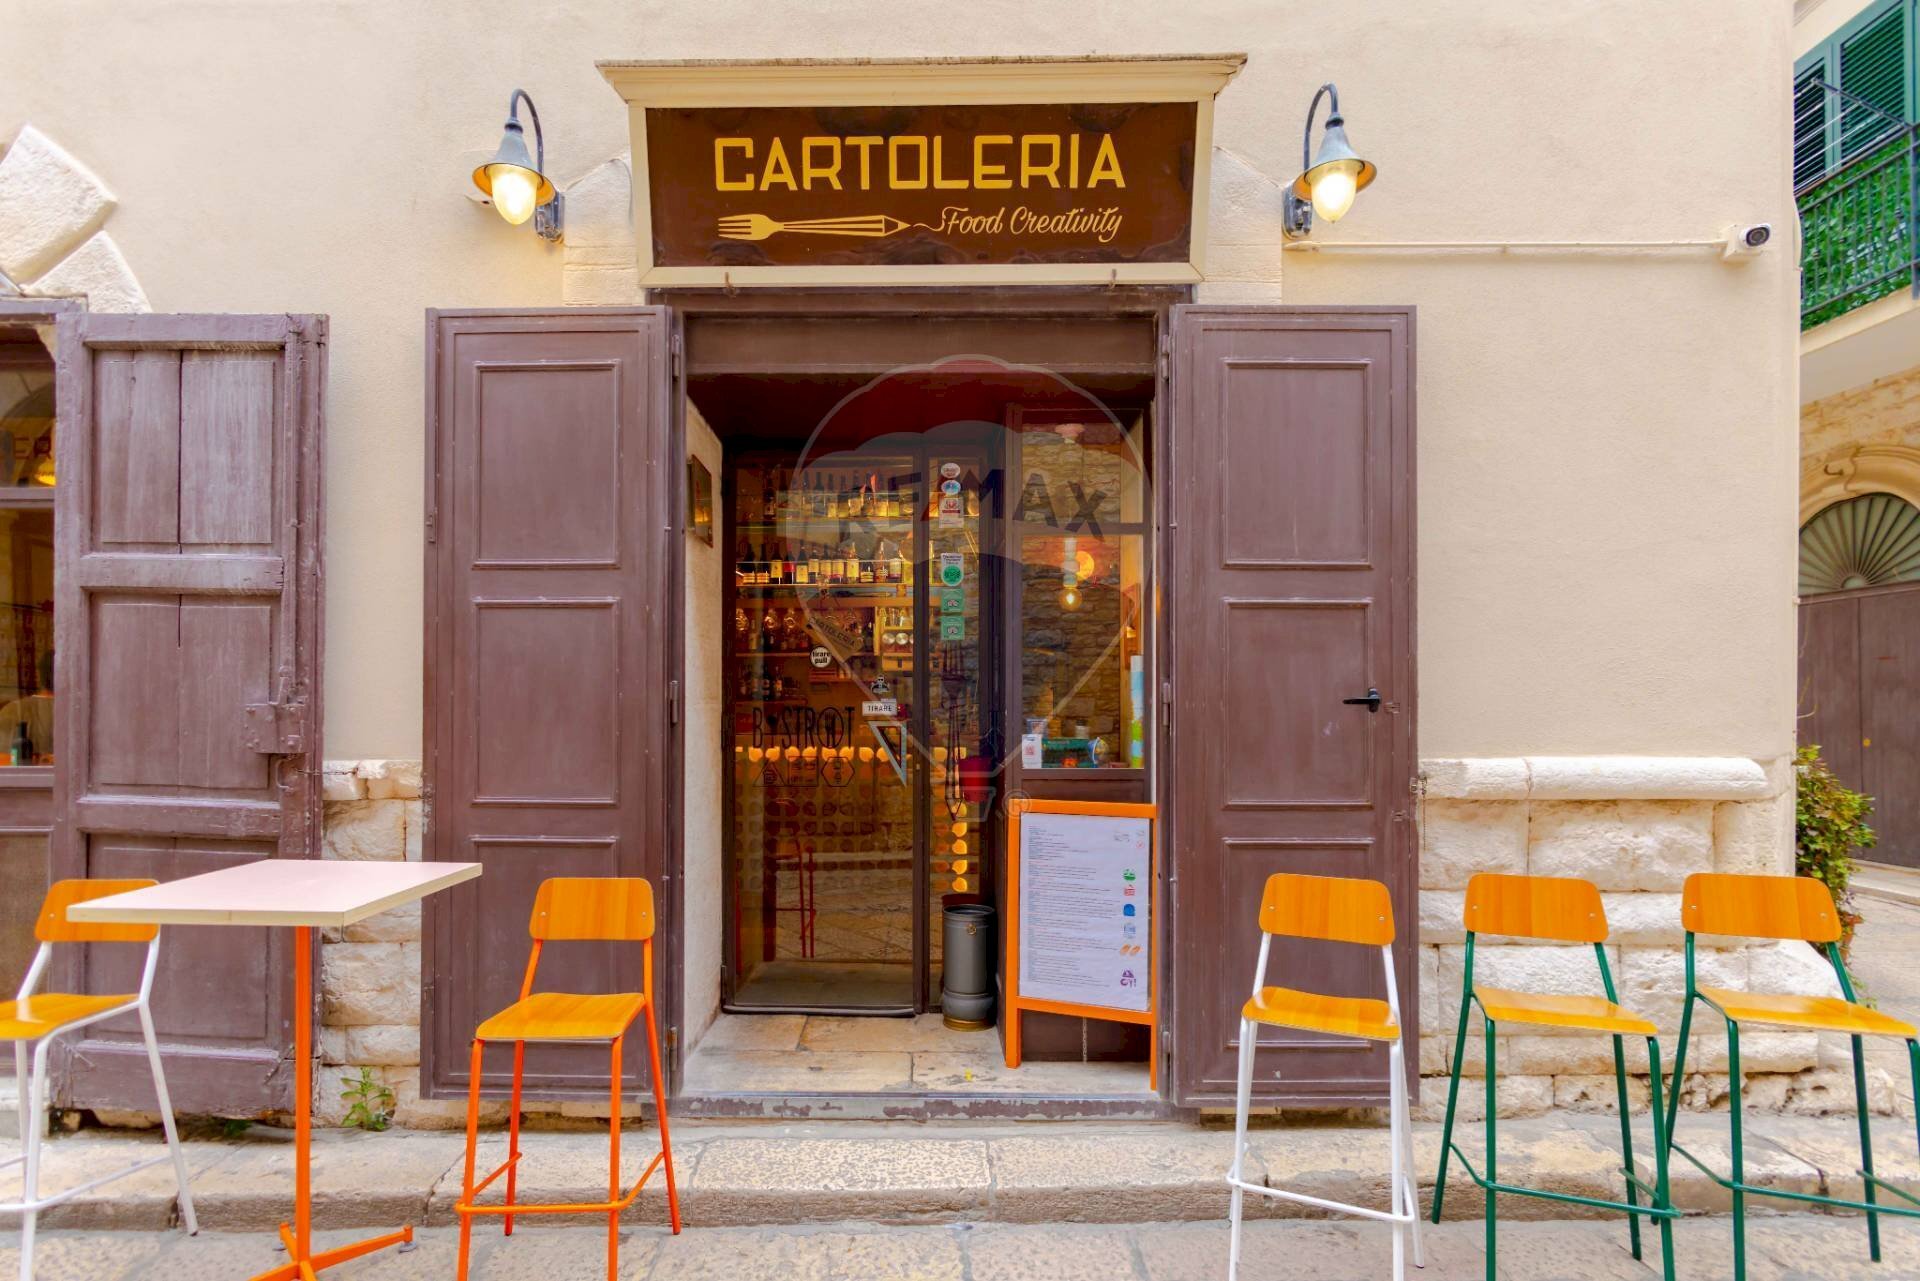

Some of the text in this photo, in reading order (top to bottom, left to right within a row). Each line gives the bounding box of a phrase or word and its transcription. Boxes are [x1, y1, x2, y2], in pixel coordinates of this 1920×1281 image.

[714, 133, 1126, 191] CARTOLERIA
[942, 205, 1122, 243] Food Creativity
[867, 704, 893, 712] TIRARE
